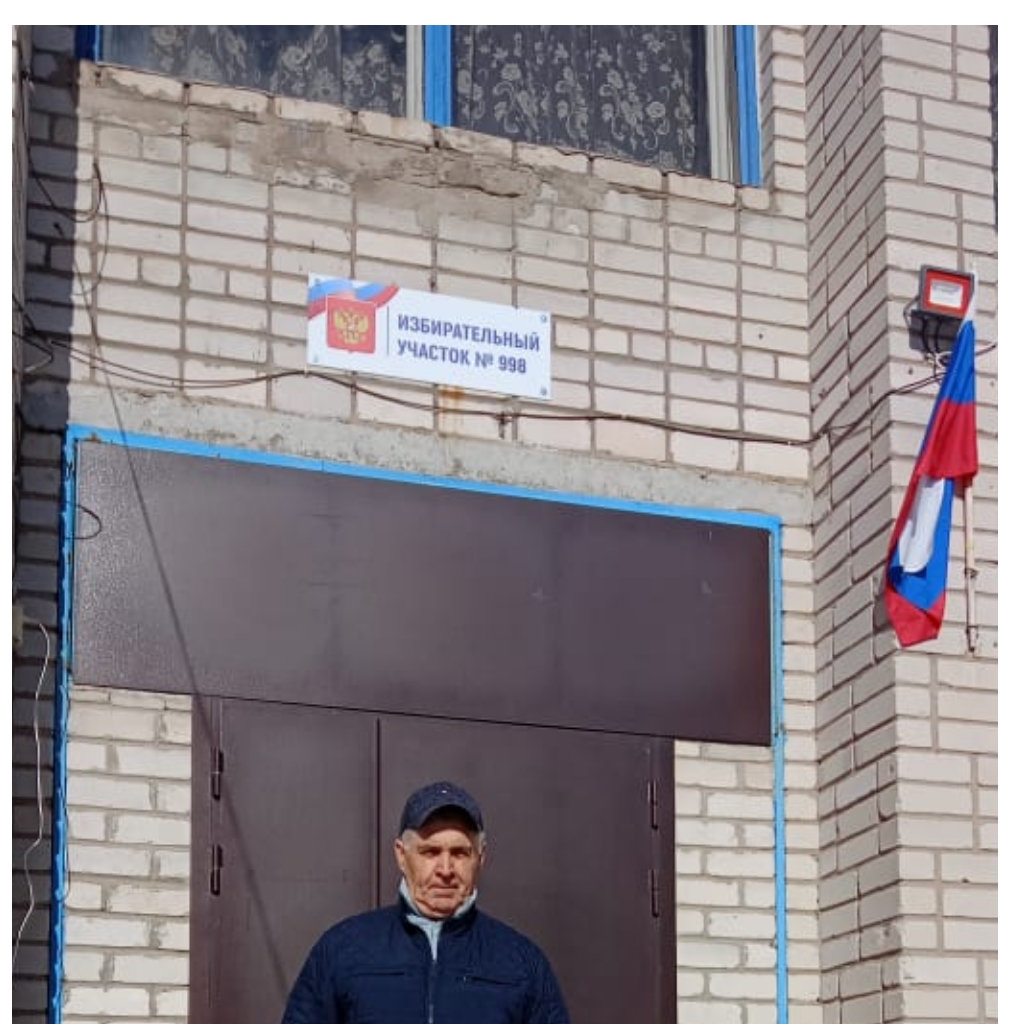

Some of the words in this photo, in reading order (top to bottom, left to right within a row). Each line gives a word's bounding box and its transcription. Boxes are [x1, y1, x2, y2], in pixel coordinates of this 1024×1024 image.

[397, 313, 540, 351] ИЗБИРАТЕЛЬНЫЙ
[397, 339, 470, 366] УЧАСТОК
[475, 355, 494, 368] №
[498, 355, 527, 374] 998
